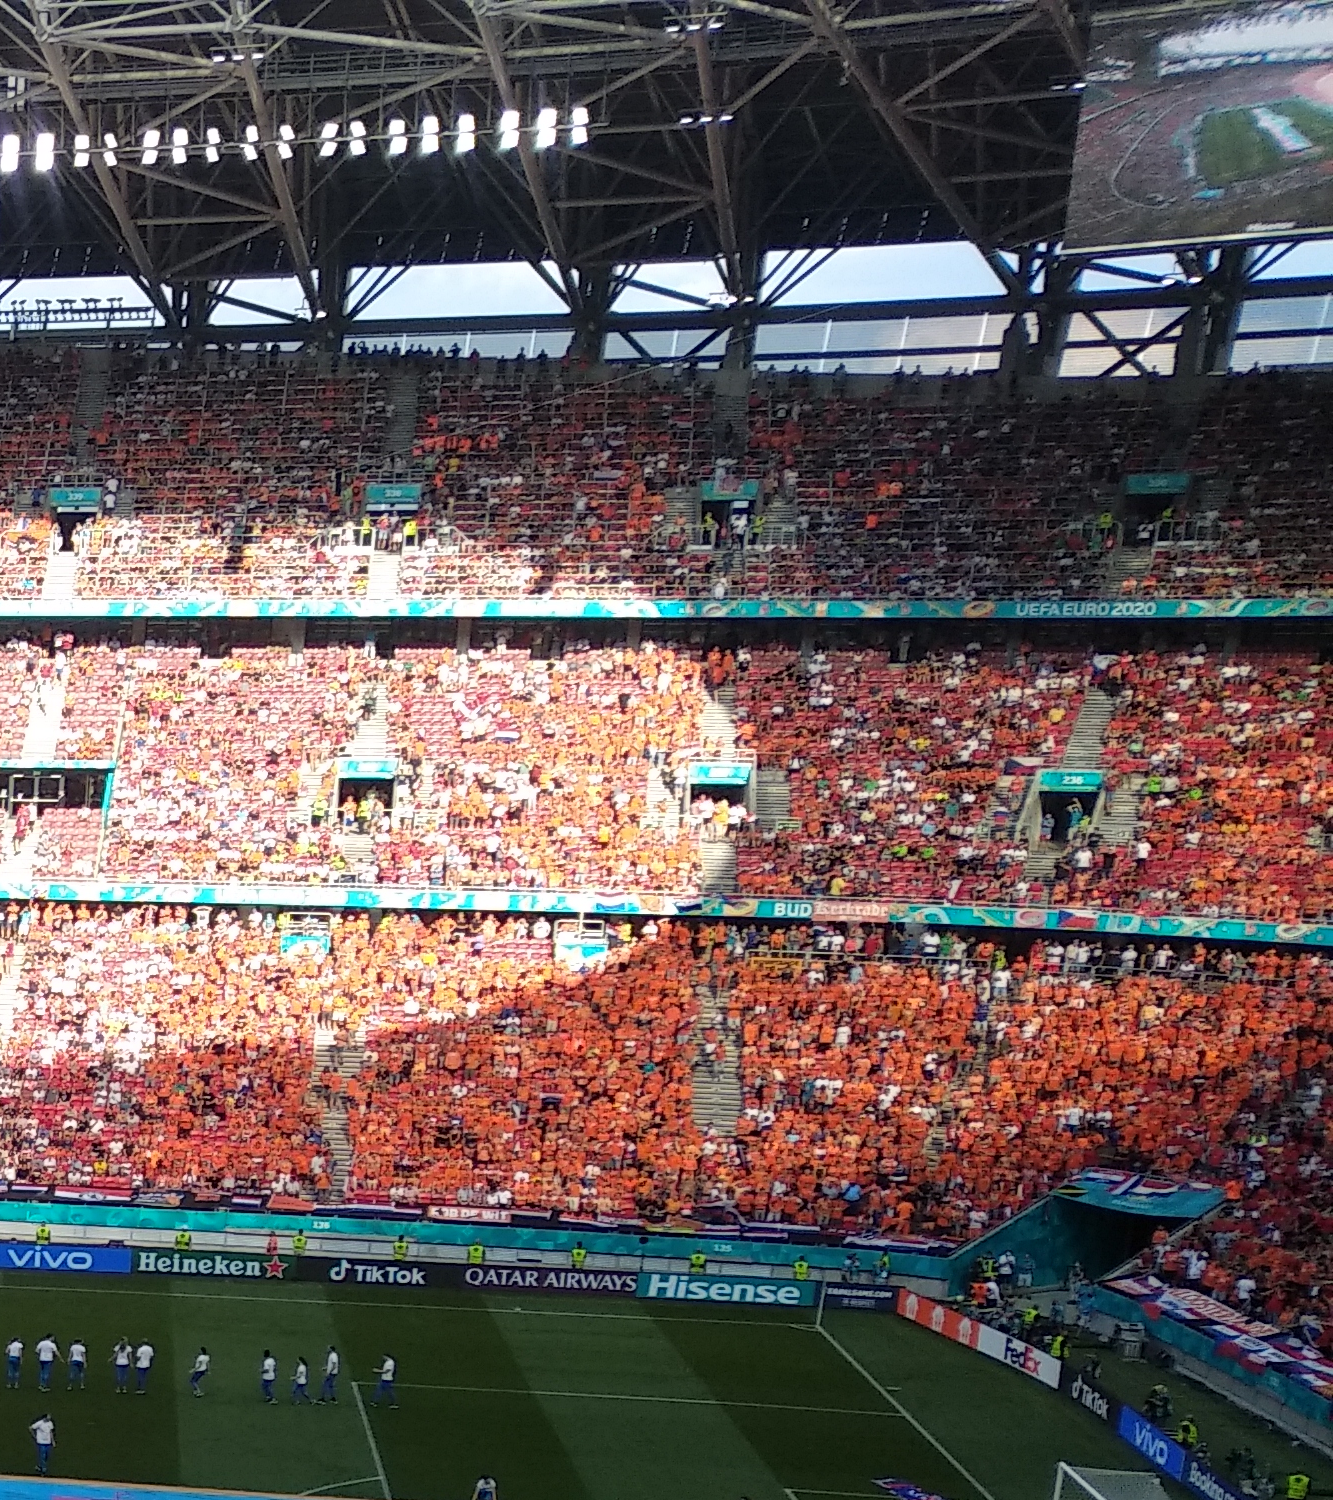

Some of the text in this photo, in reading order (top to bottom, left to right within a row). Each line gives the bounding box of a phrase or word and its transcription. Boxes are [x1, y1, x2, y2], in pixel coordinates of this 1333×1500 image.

[1015, 601, 1060, 616] UEFA
[7, 1245, 93, 1270] vivo
[137, 1252, 262, 1277] Heineken
[353, 1264, 426, 1285] TikTok
[464, 1268, 637, 1291] QATAR AIRWAYS
[648, 1274, 801, 1305] Hisense
[1004, 1337, 1041, 1377] FedEx
[1134, 1421, 1169, 1466] vivo
